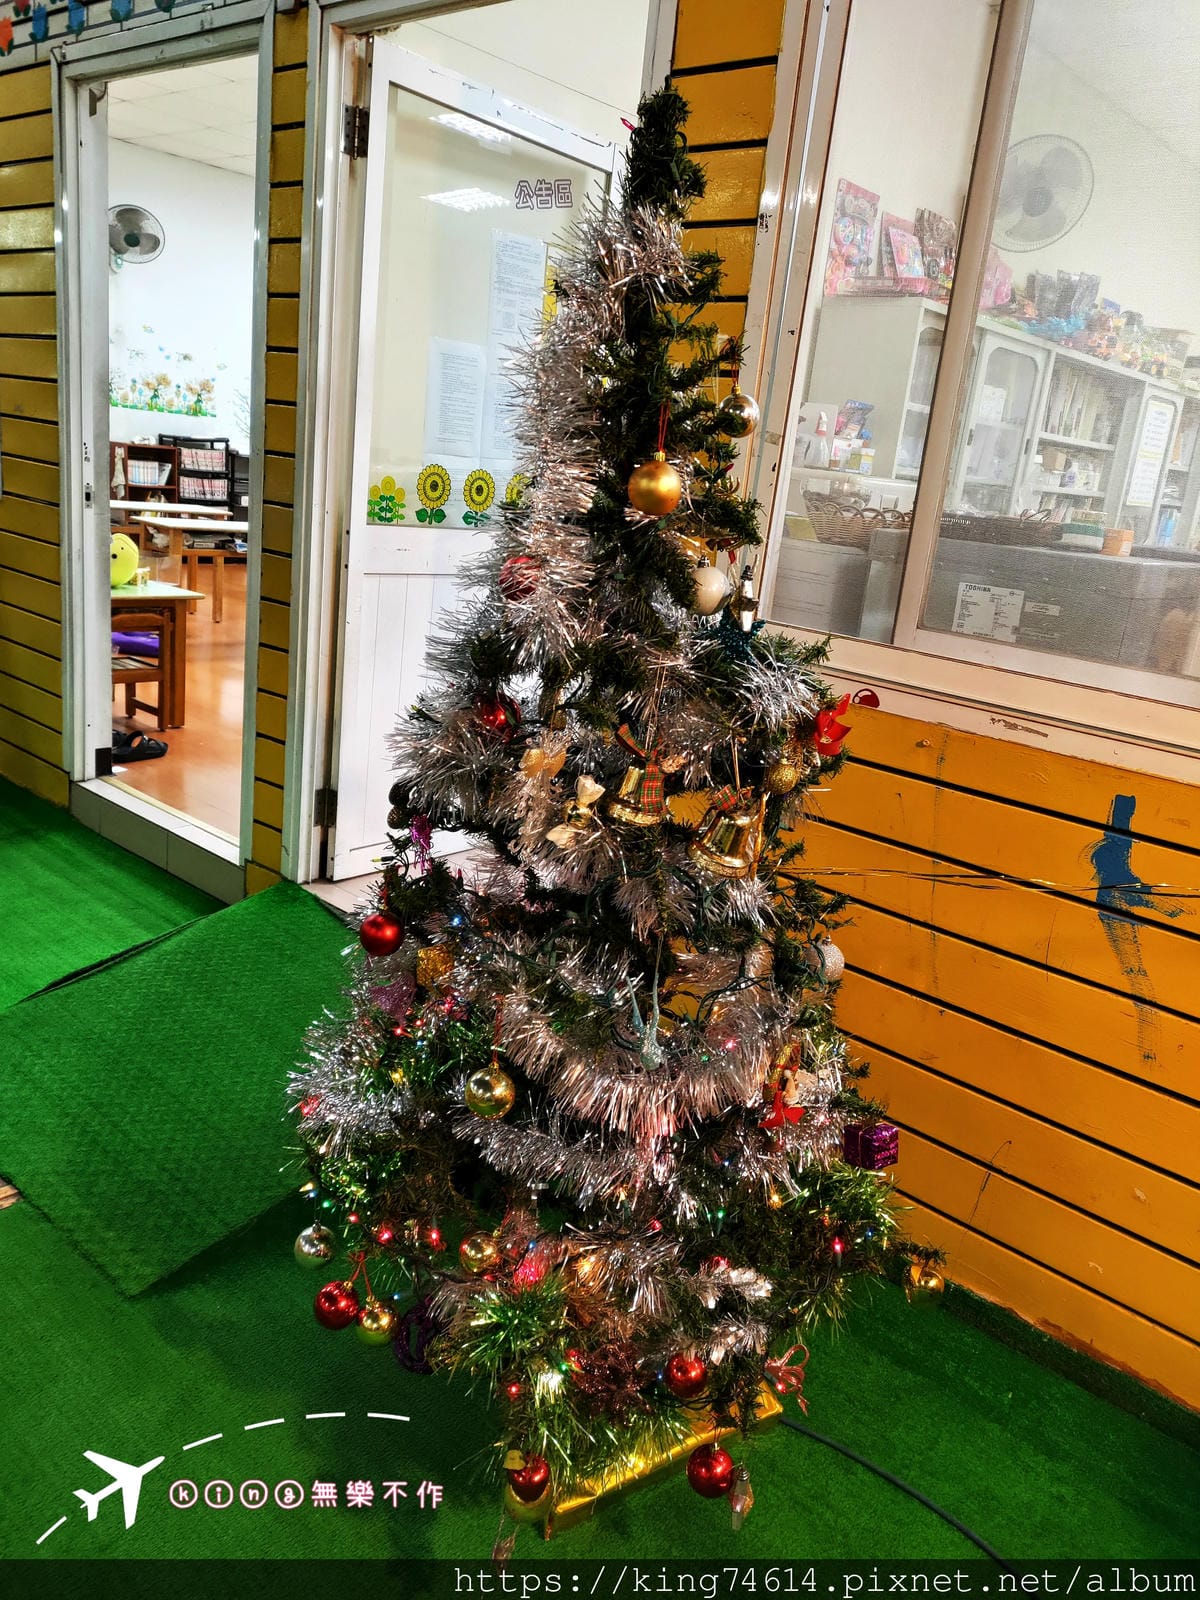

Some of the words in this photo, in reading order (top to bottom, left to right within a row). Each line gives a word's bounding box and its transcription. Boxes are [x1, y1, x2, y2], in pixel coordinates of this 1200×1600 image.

[515, 179, 573, 210] 公告區
[965, 583, 991, 593] TOSHIBA
